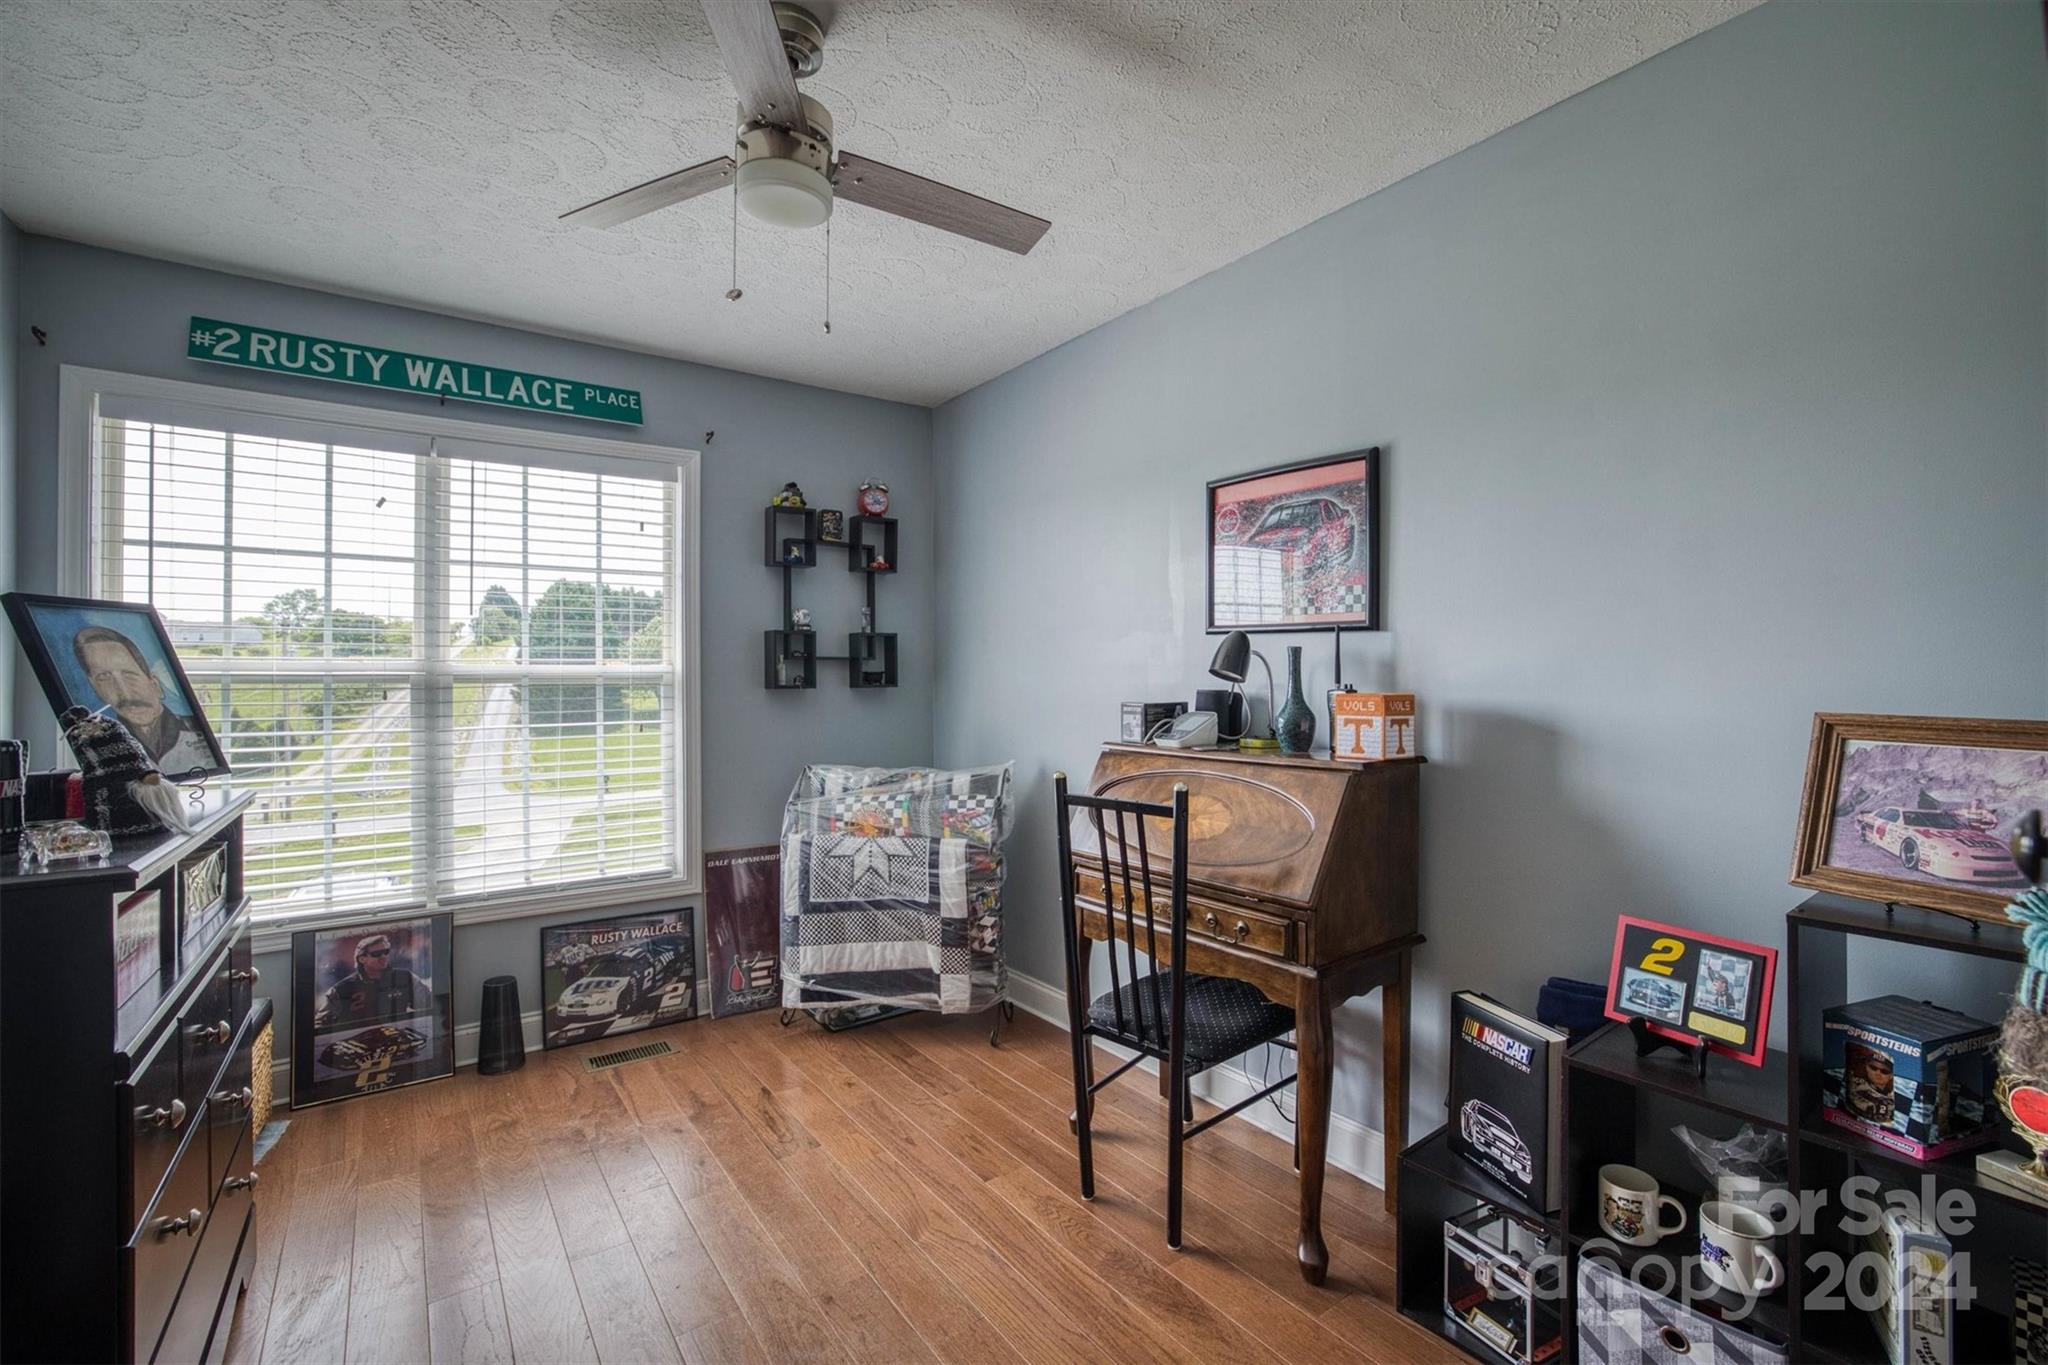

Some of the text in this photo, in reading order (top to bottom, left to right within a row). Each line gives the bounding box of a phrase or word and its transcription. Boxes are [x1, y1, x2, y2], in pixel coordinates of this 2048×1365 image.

[248, 332, 390, 382] RUSTY
[404, 358, 575, 411] WALLACE
[584, 387, 640, 410] PLACE
[1343, 700, 1376, 712] VOLS
[1390, 700, 1411, 712] VOLS
[1343, 718, 1374, 753] T
[1390, 718, 1410, 754] T
[707, 858, 730, 868] DALE
[591, 921, 684, 946] RUSTY WALLACE
[1639, 937, 1686, 976] 2
[642, 968, 655, 990] 2
[659, 981, 688, 1007] 2
[1461, 1032, 1531, 1075] THE COMPLETE HISTORY
[1482, 1026, 1532, 1065] NASCAR
[1847, 1025, 1921, 1058] SPORTSTEINS
